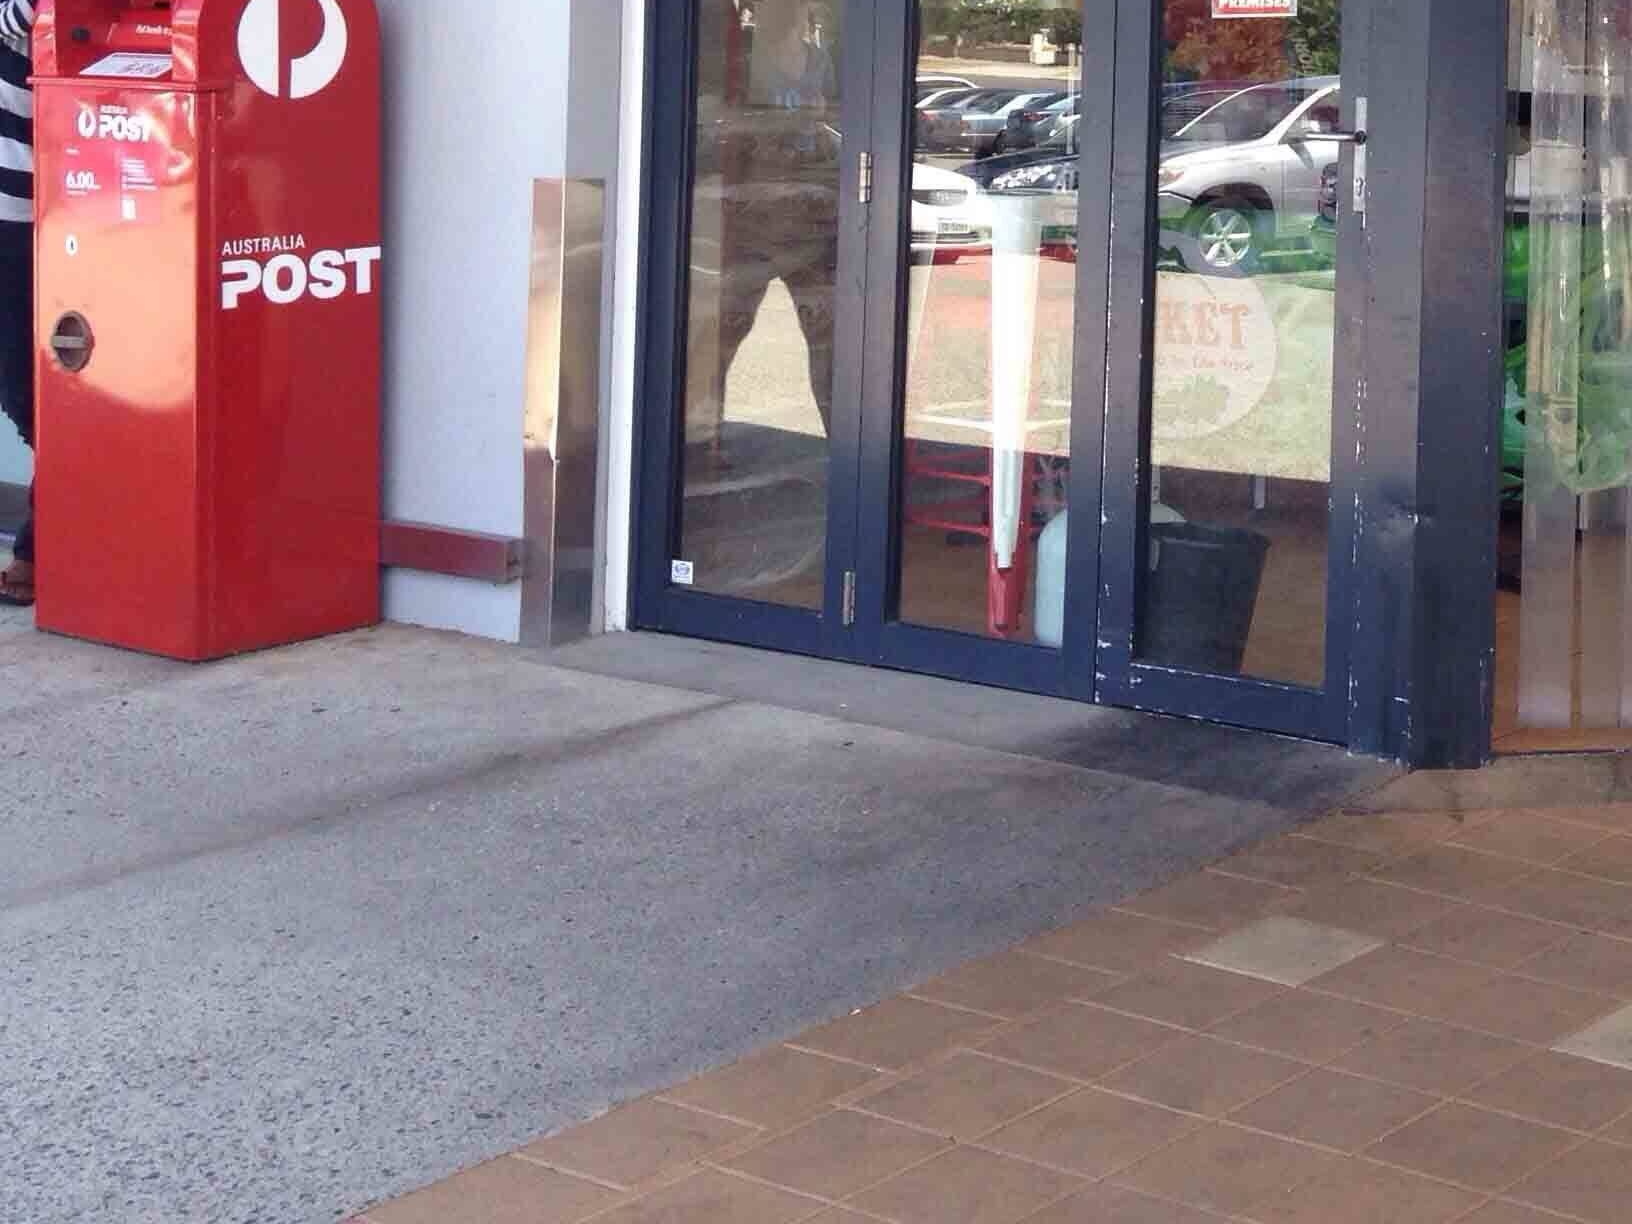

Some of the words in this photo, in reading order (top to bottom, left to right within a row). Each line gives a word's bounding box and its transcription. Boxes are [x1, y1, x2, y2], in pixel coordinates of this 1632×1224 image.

[98, 114, 151, 143] POST
[222, 234, 306, 257] AUSTRALIA
[221, 245, 382, 311] POST
